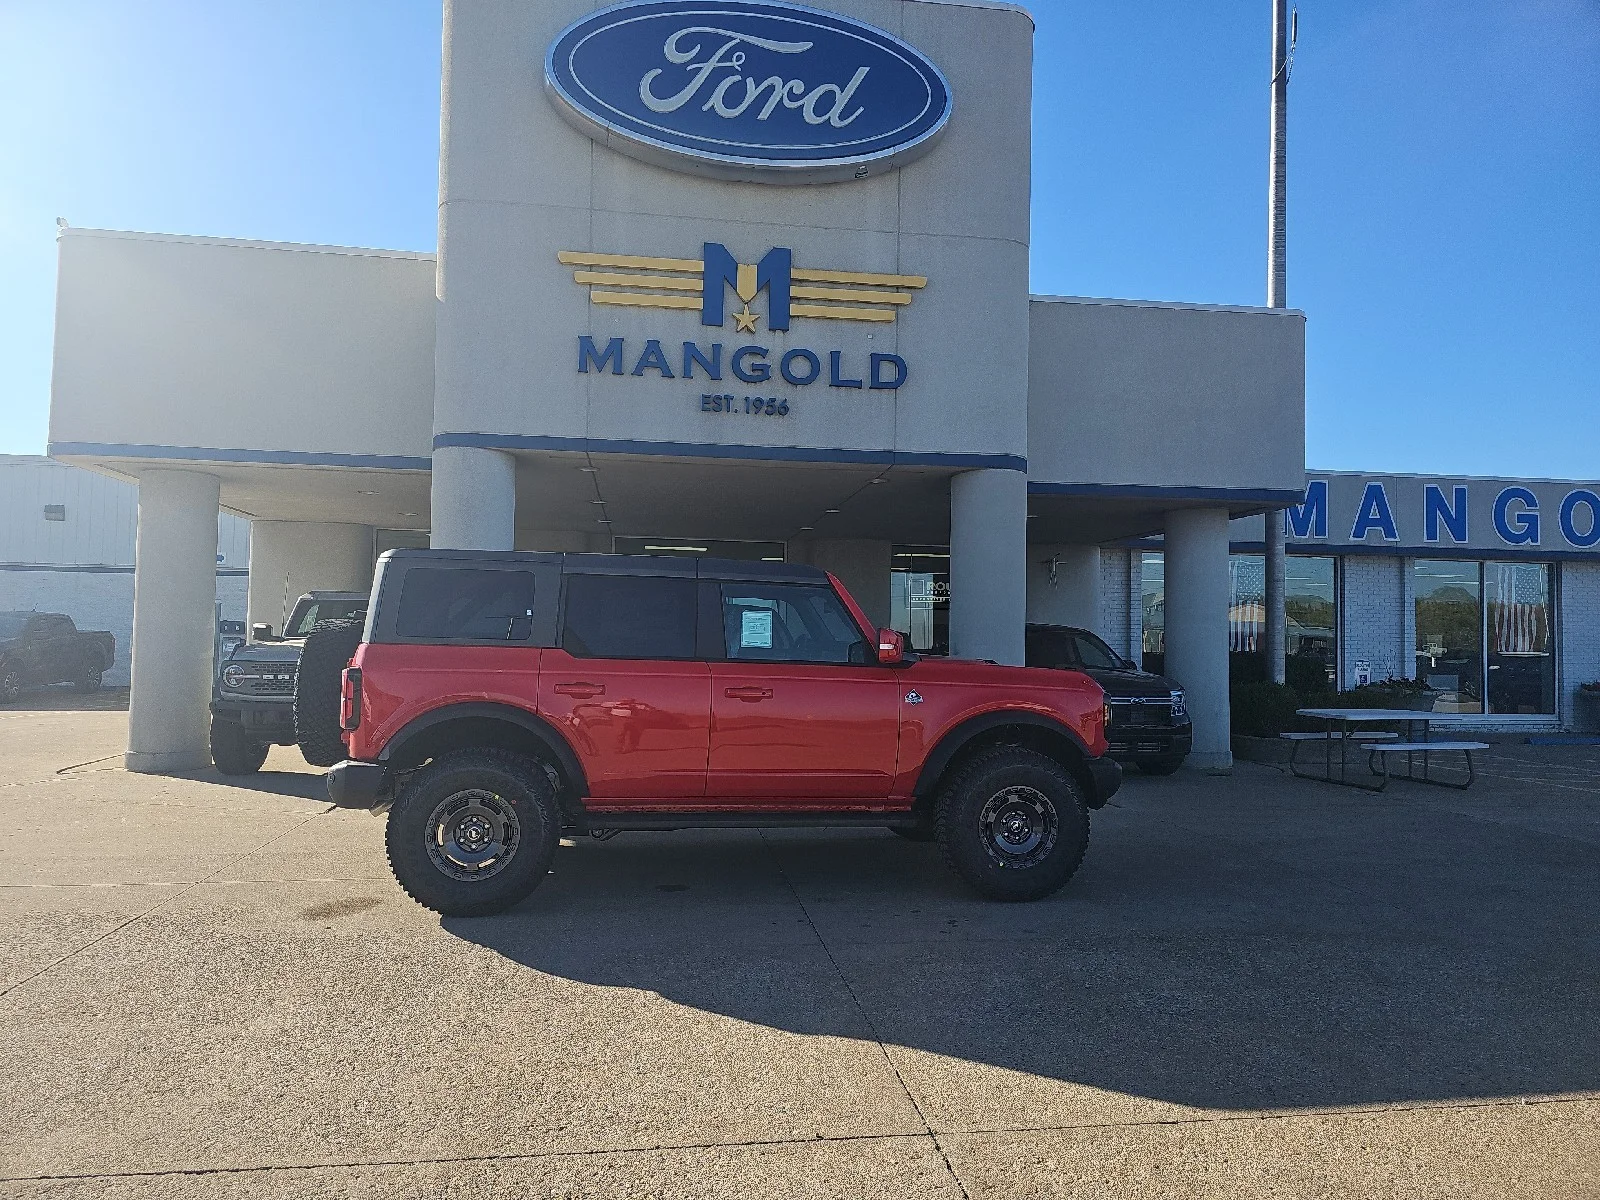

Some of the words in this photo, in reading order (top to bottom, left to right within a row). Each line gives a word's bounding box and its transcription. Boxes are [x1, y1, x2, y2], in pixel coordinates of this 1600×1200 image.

[639, 26, 870, 128] Ford
[577, 335, 908, 390] MANGOLD
[701, 393, 738, 413] EST.
[744, 396, 790, 416] 1956
[1284, 480, 1600, 549] MANGO
